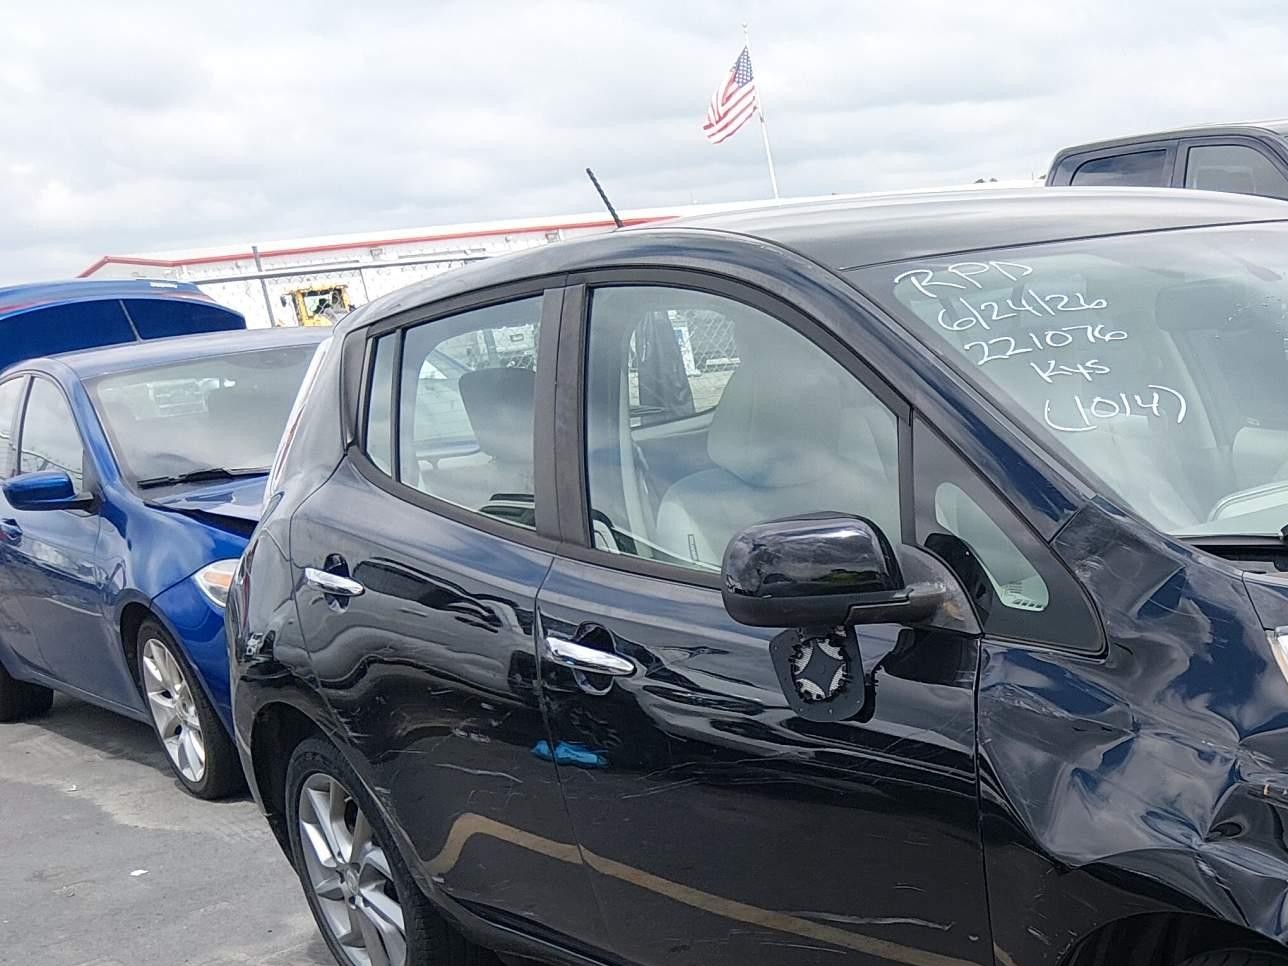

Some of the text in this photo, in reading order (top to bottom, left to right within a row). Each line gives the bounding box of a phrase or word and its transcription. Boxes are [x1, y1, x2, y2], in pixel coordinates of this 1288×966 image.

[937, 288, 1108, 331] 6/24/26
[963, 324, 1128, 366] 221076
[1044, 384, 1187, 432] (1014)
